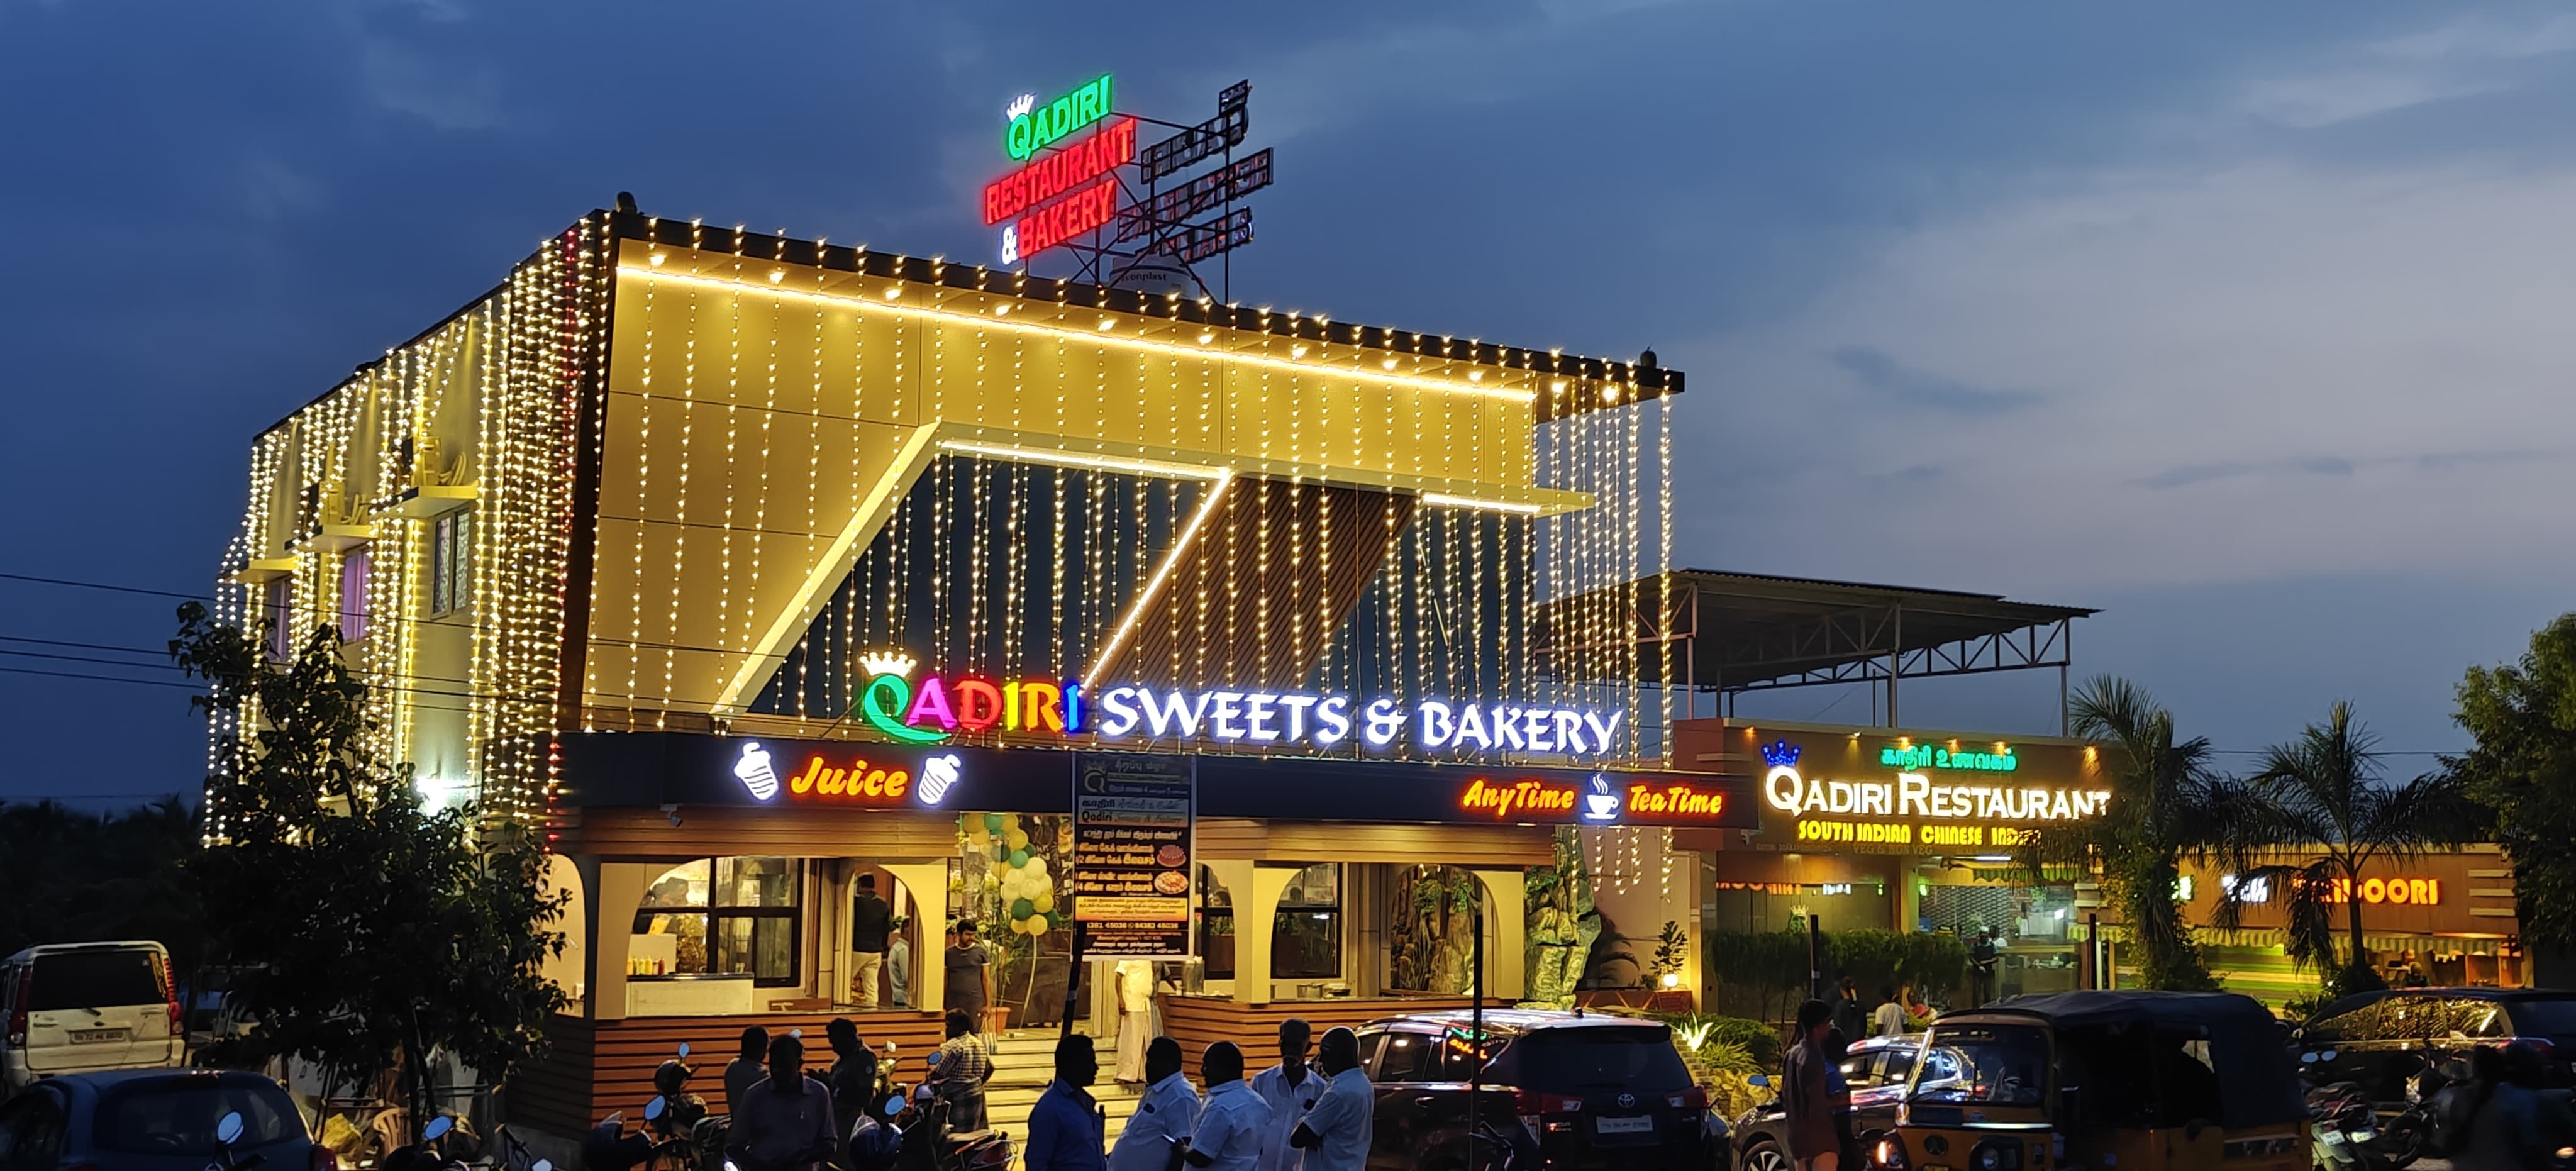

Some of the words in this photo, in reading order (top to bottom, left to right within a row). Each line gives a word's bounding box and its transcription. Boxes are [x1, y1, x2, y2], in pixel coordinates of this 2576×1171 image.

[1007, 72, 1113, 161] QADIRI
[985, 118, 1137, 225] RESTAURANT
[1002, 225, 1018, 265] &
[1018, 180, 1117, 259] BAKERY
[864, 674, 1080, 741] QADIRI
[1101, 687, 1350, 746] SWEETS
[1365, 695, 1407, 746] &
[1417, 700, 1623, 755] BAKERY
[791, 757, 909, 797] Juice
[1881, 745, 1932, 772] காதிரி
[1936, 748, 2017, 771] உணவகம்
[1463, 779, 1574, 816] AnyTime
[1765, 767, 1892, 816] QADIRI
[1898, 773, 2112, 819] RESTAURANT
[1082, 811, 1113, 823] Qadiri
[1799, 821, 1853, 842] SOUTH
[1857, 823, 1911, 845] INDIAN
[1921, 826, 1982, 846] CHINESE
